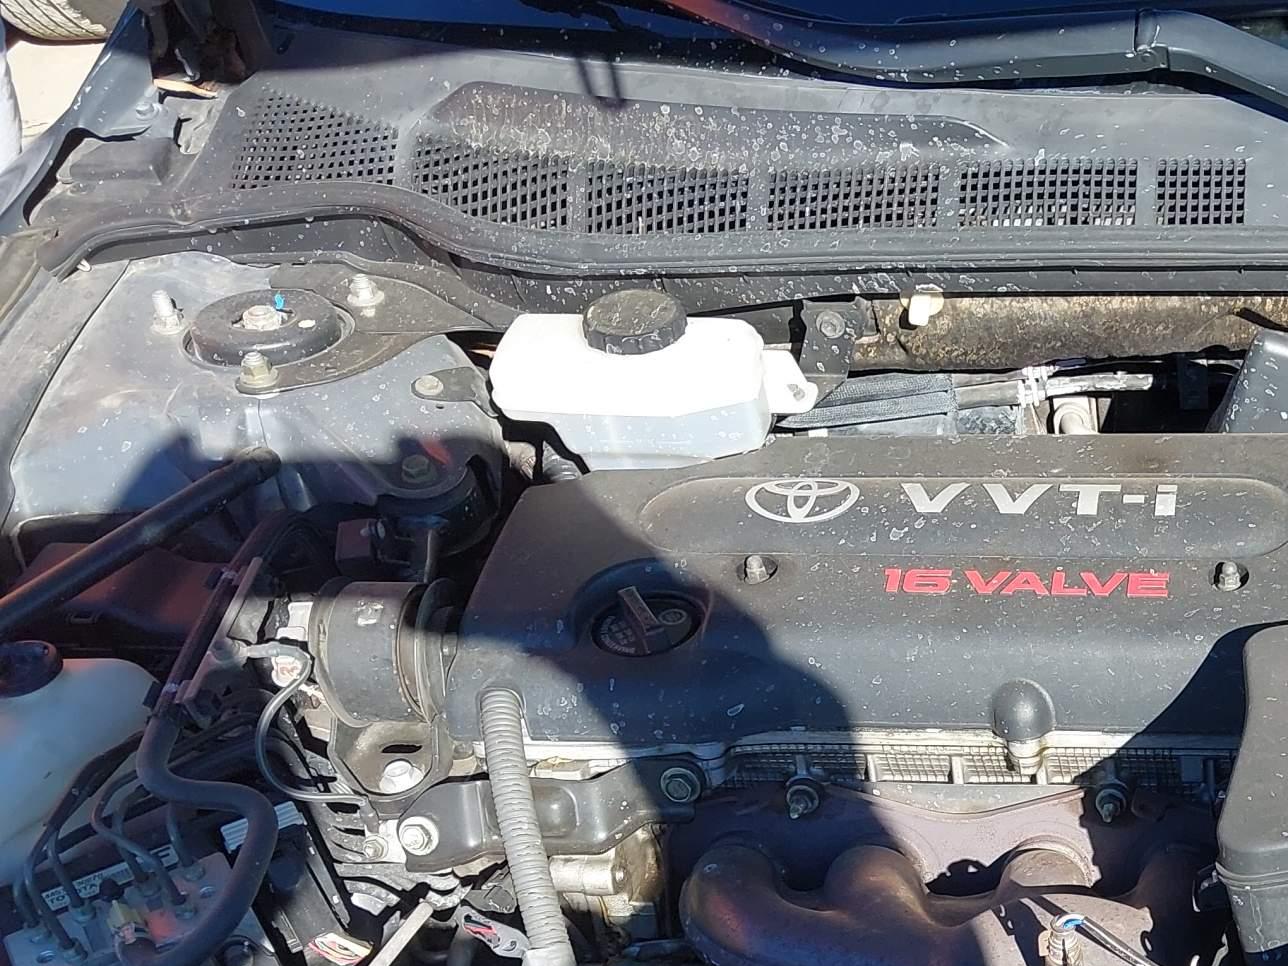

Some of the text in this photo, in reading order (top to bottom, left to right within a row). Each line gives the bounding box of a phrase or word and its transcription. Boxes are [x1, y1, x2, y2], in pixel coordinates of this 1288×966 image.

[900, 482, 1178, 517] VVT-i
[884, 568, 1170, 597] 16 VALVE
